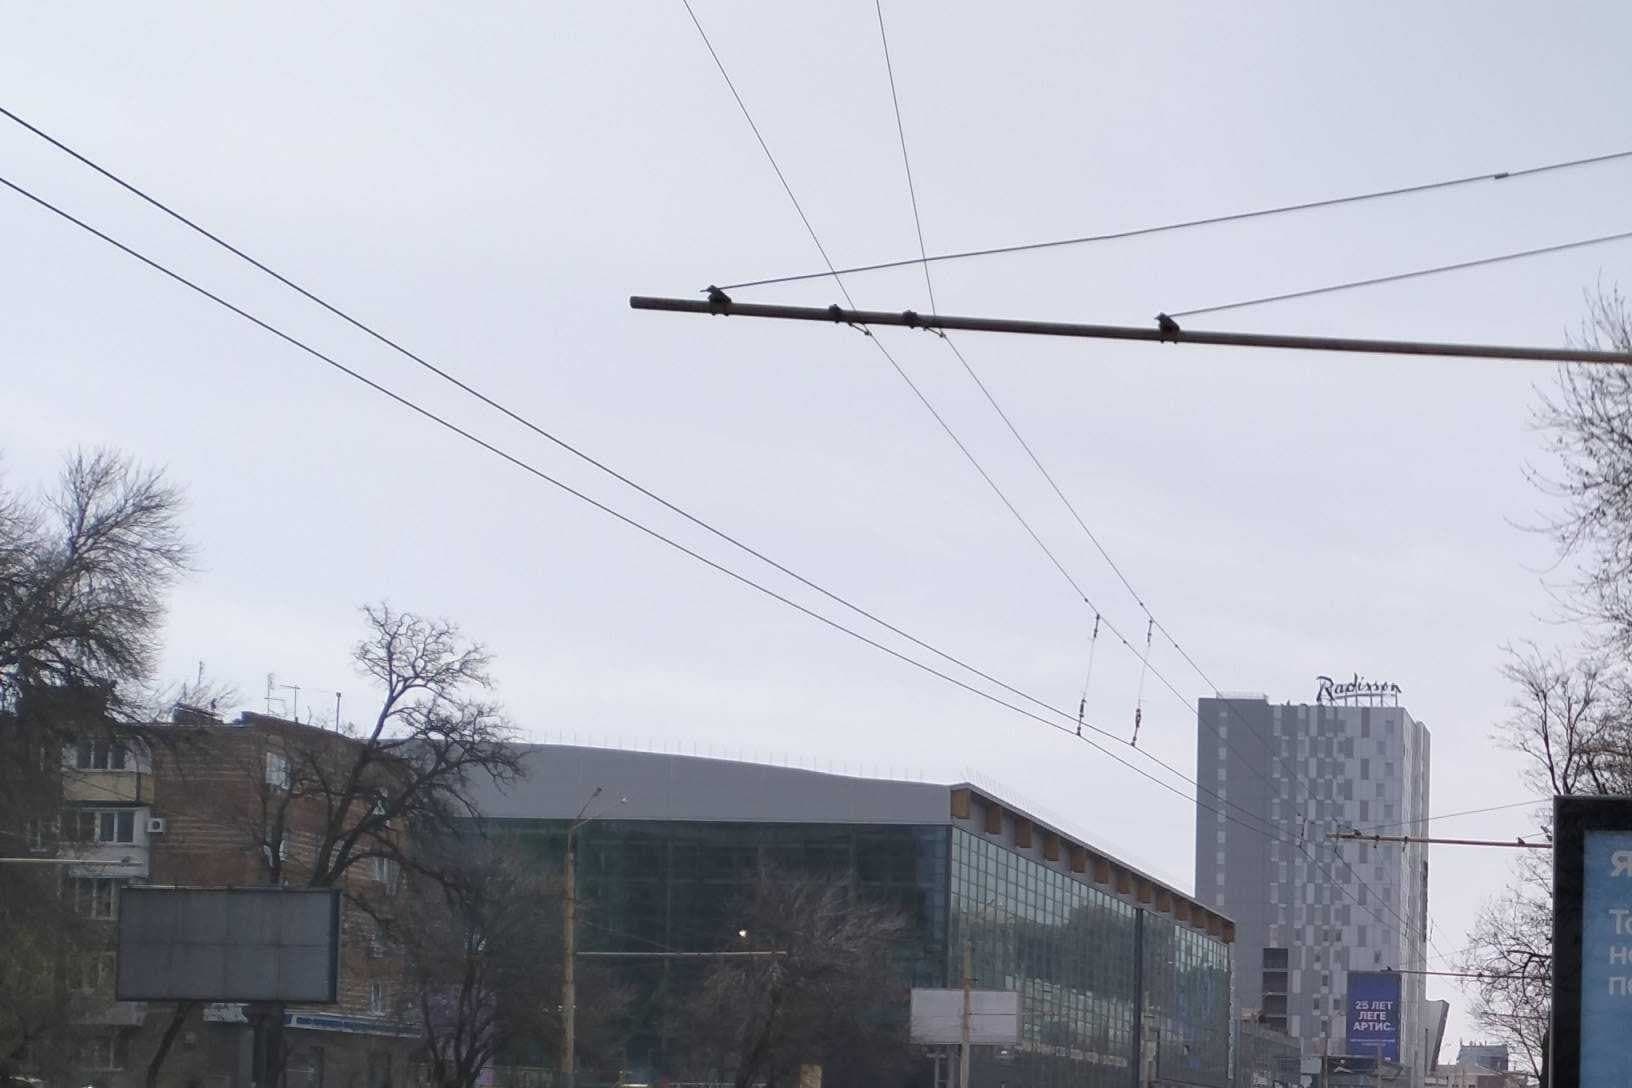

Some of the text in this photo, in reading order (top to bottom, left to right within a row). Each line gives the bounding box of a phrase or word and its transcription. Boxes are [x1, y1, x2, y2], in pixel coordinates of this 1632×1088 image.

[1316, 672, 1402, 701] Radisson
[1354, 1000, 1393, 1010] 25 ЛЕТ
[1359, 1011, 1387, 1021] ЛЕГЕ
